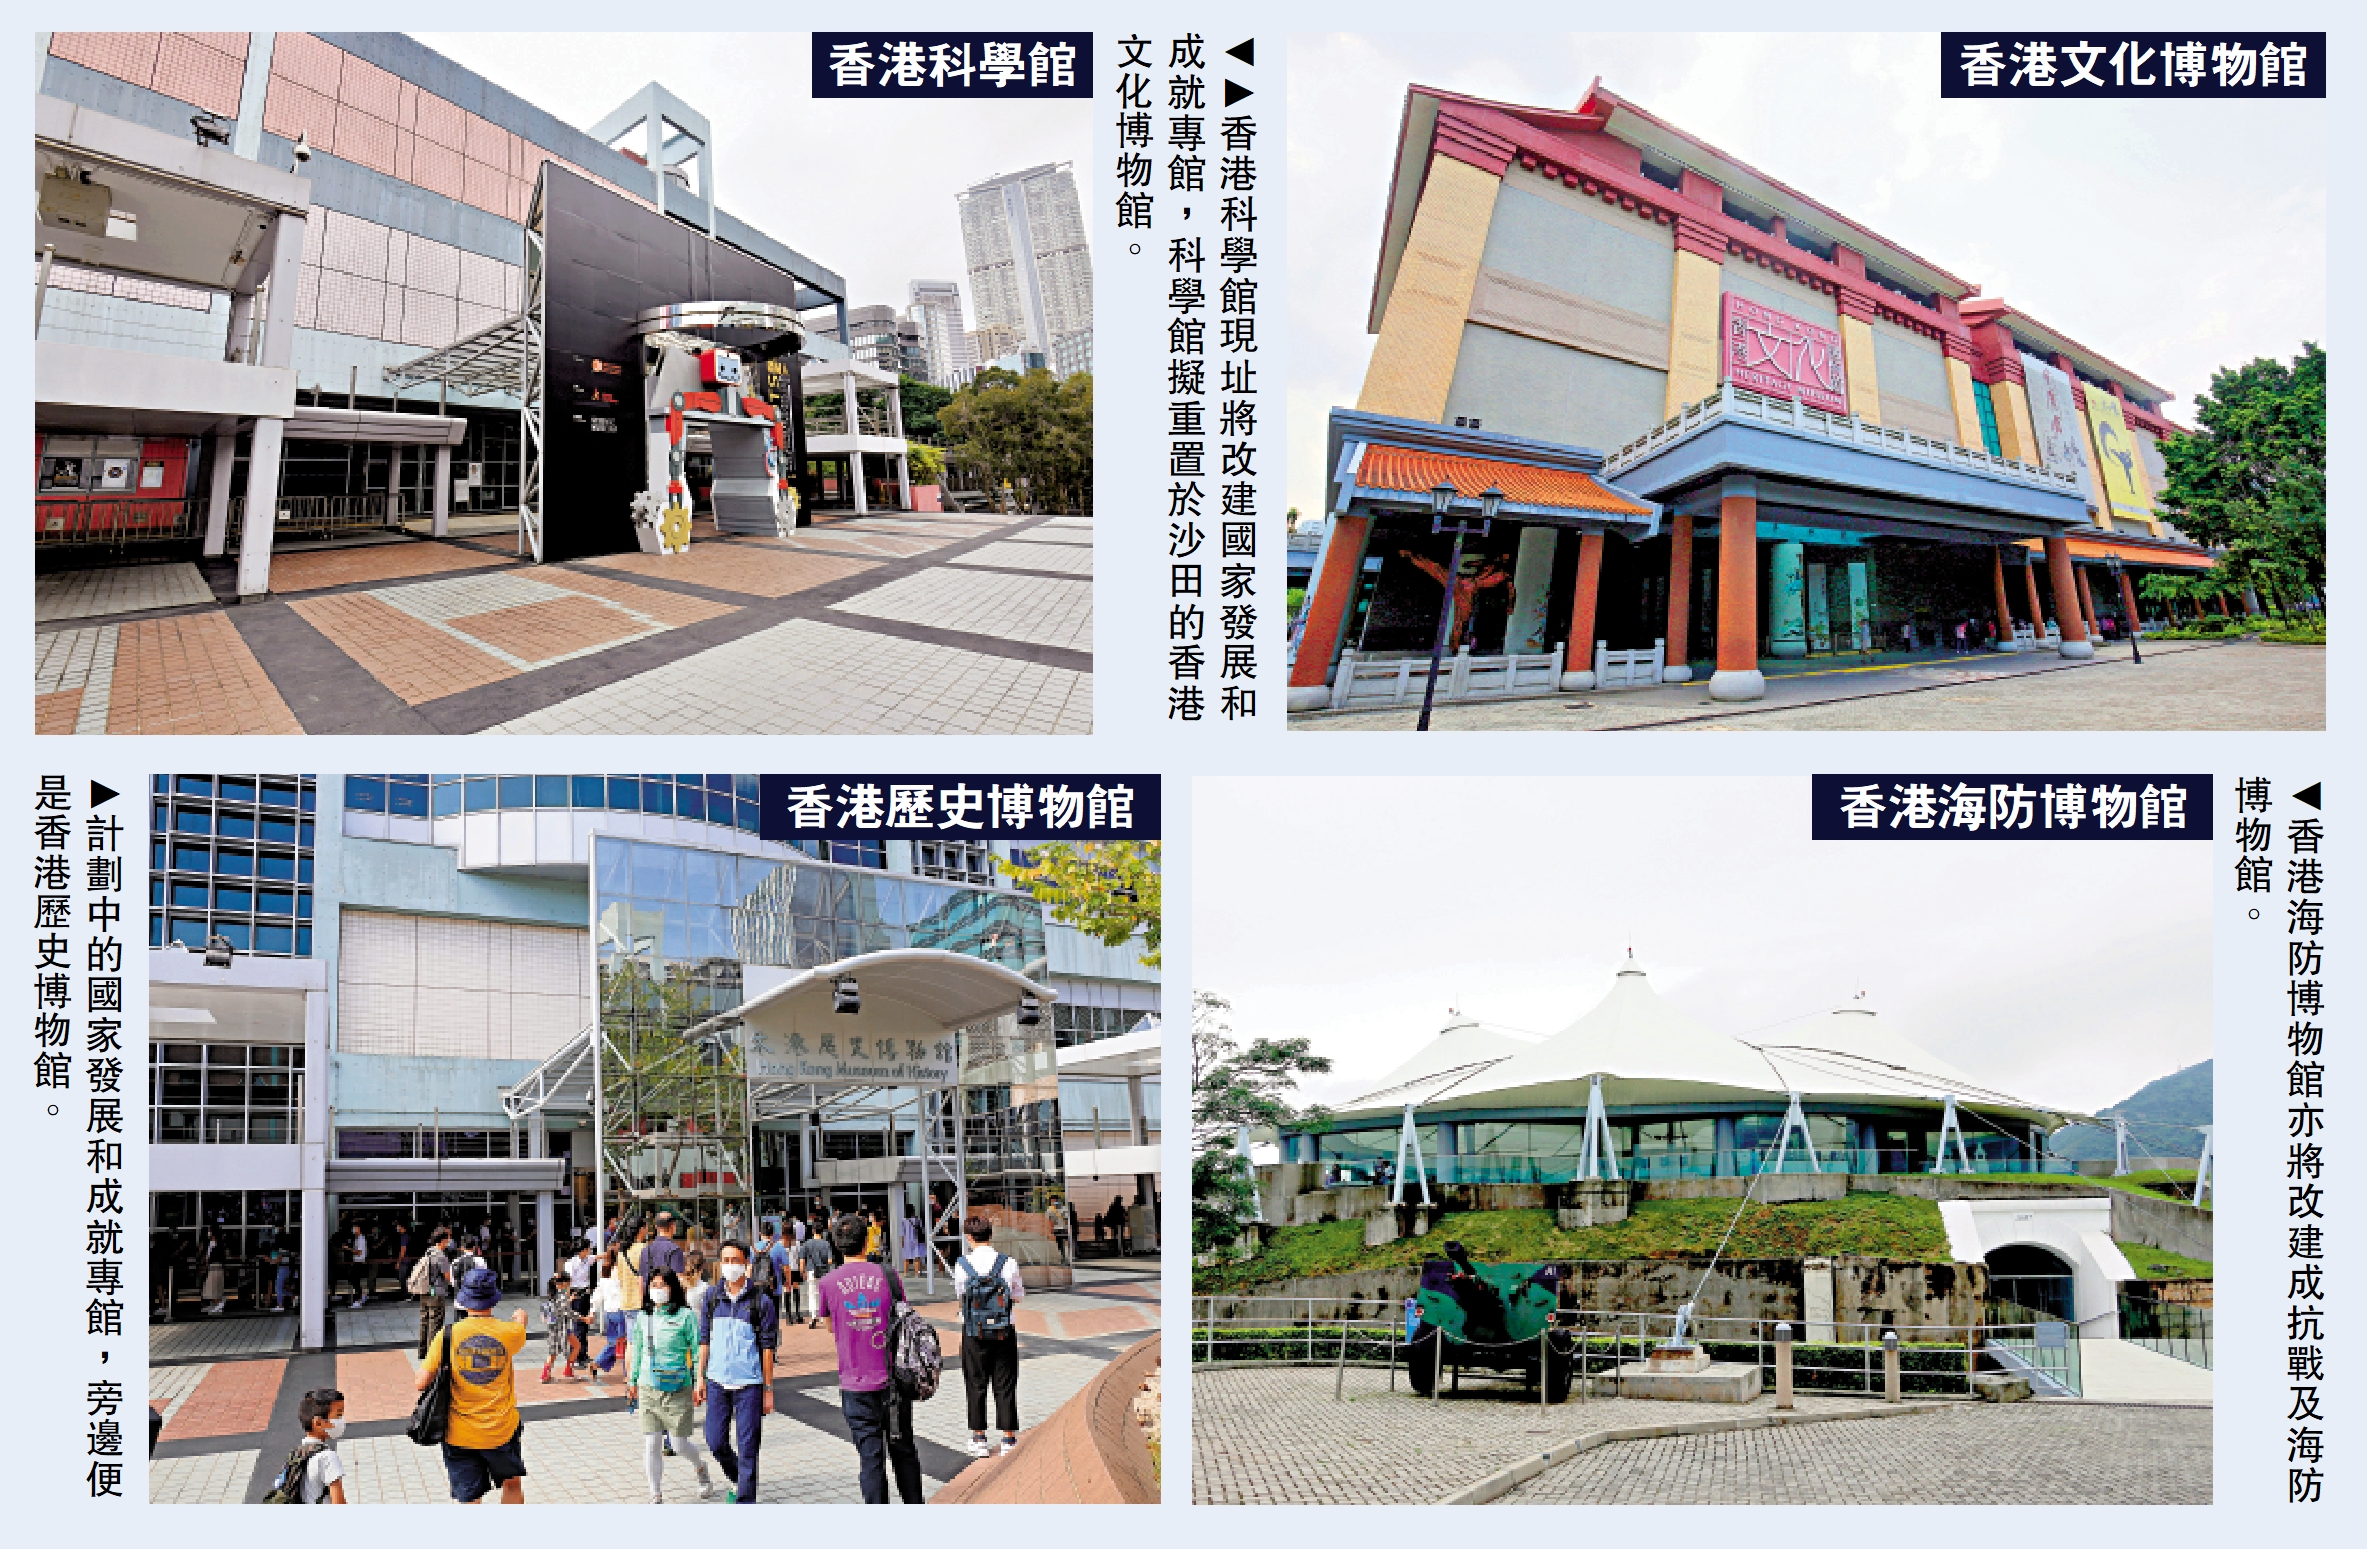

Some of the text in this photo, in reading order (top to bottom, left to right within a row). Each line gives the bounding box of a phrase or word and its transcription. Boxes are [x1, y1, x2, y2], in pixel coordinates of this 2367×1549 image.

[756, 1059, 949, 1083] Hong Kong Museum of History
